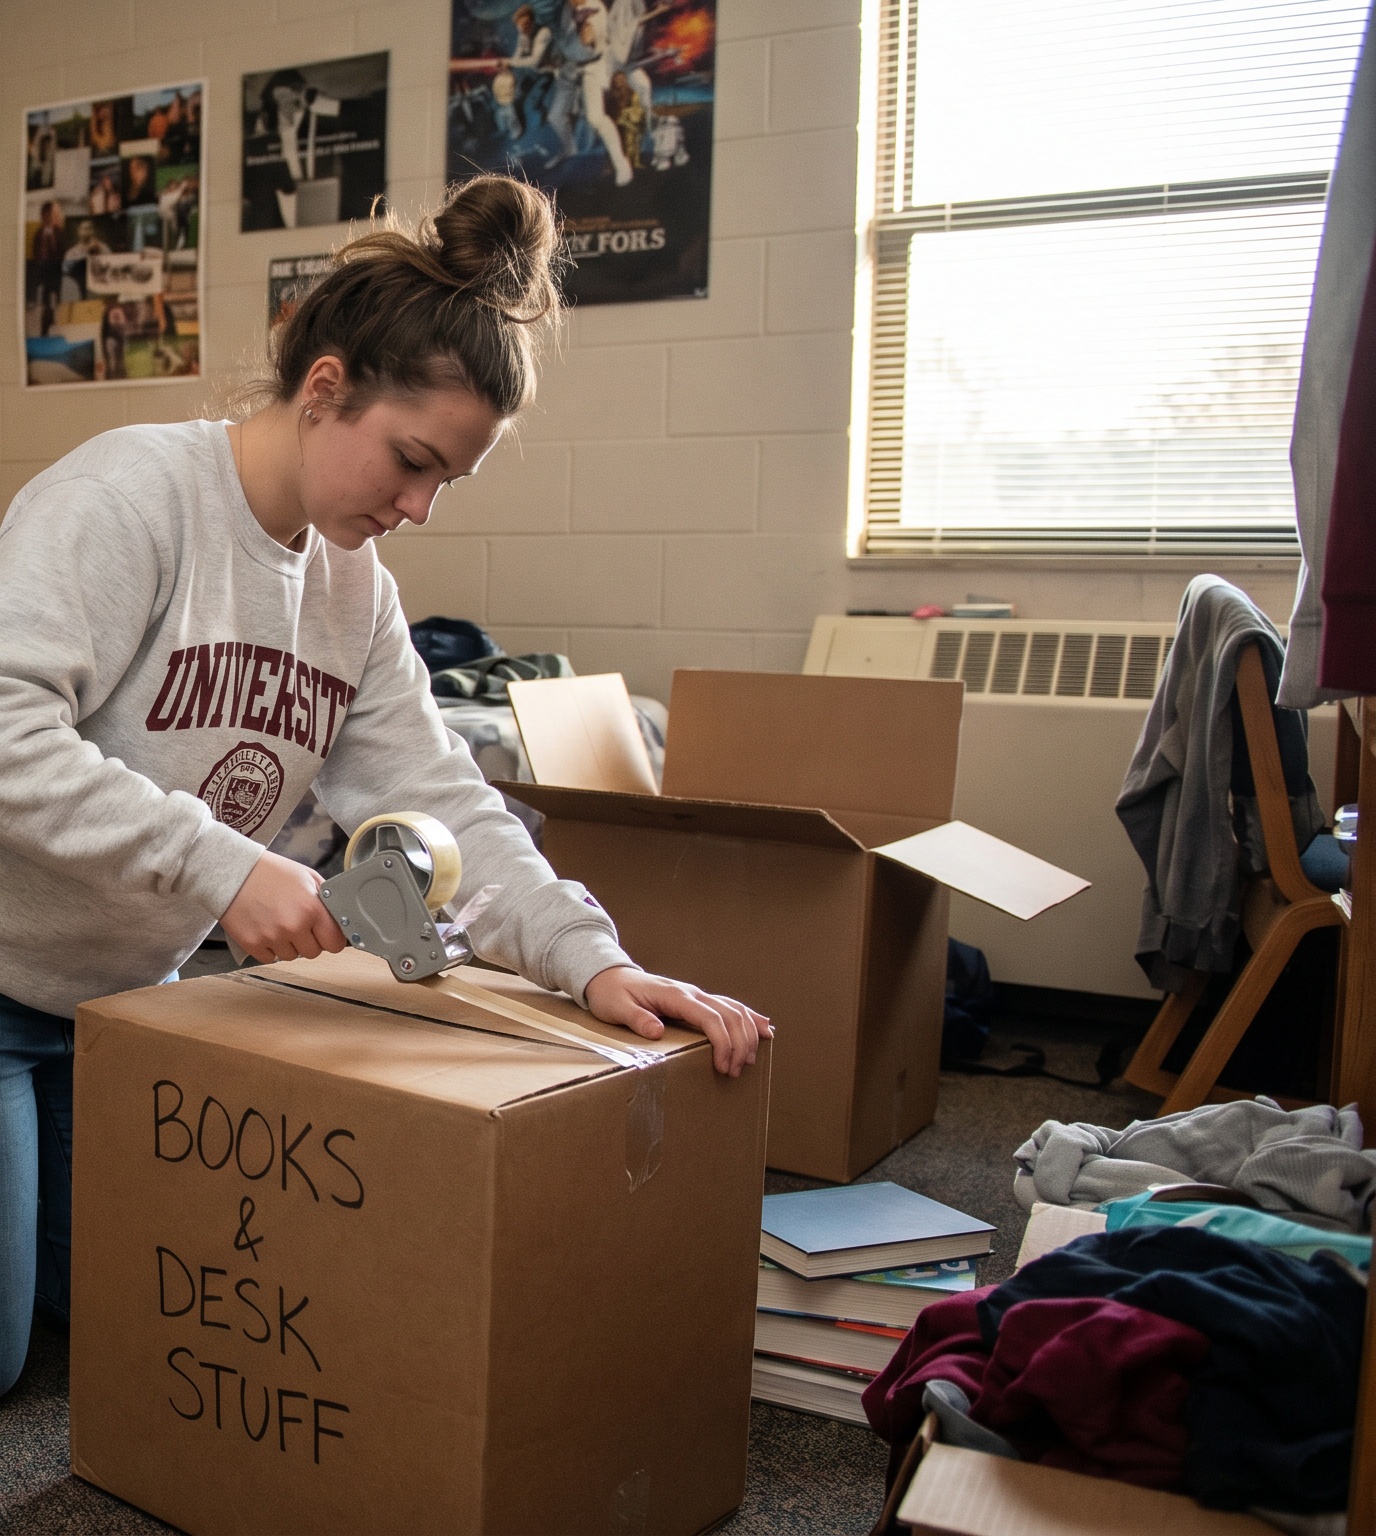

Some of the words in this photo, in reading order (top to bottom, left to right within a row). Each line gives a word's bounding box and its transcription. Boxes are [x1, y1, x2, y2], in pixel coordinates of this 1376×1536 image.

[598, 227, 666, 254] FORS
[152, 1079, 365, 1210] BOOKS
[233, 1195, 264, 1263] &
[155, 1245, 322, 1373] DESK
[166, 1346, 351, 1466] STUFF
